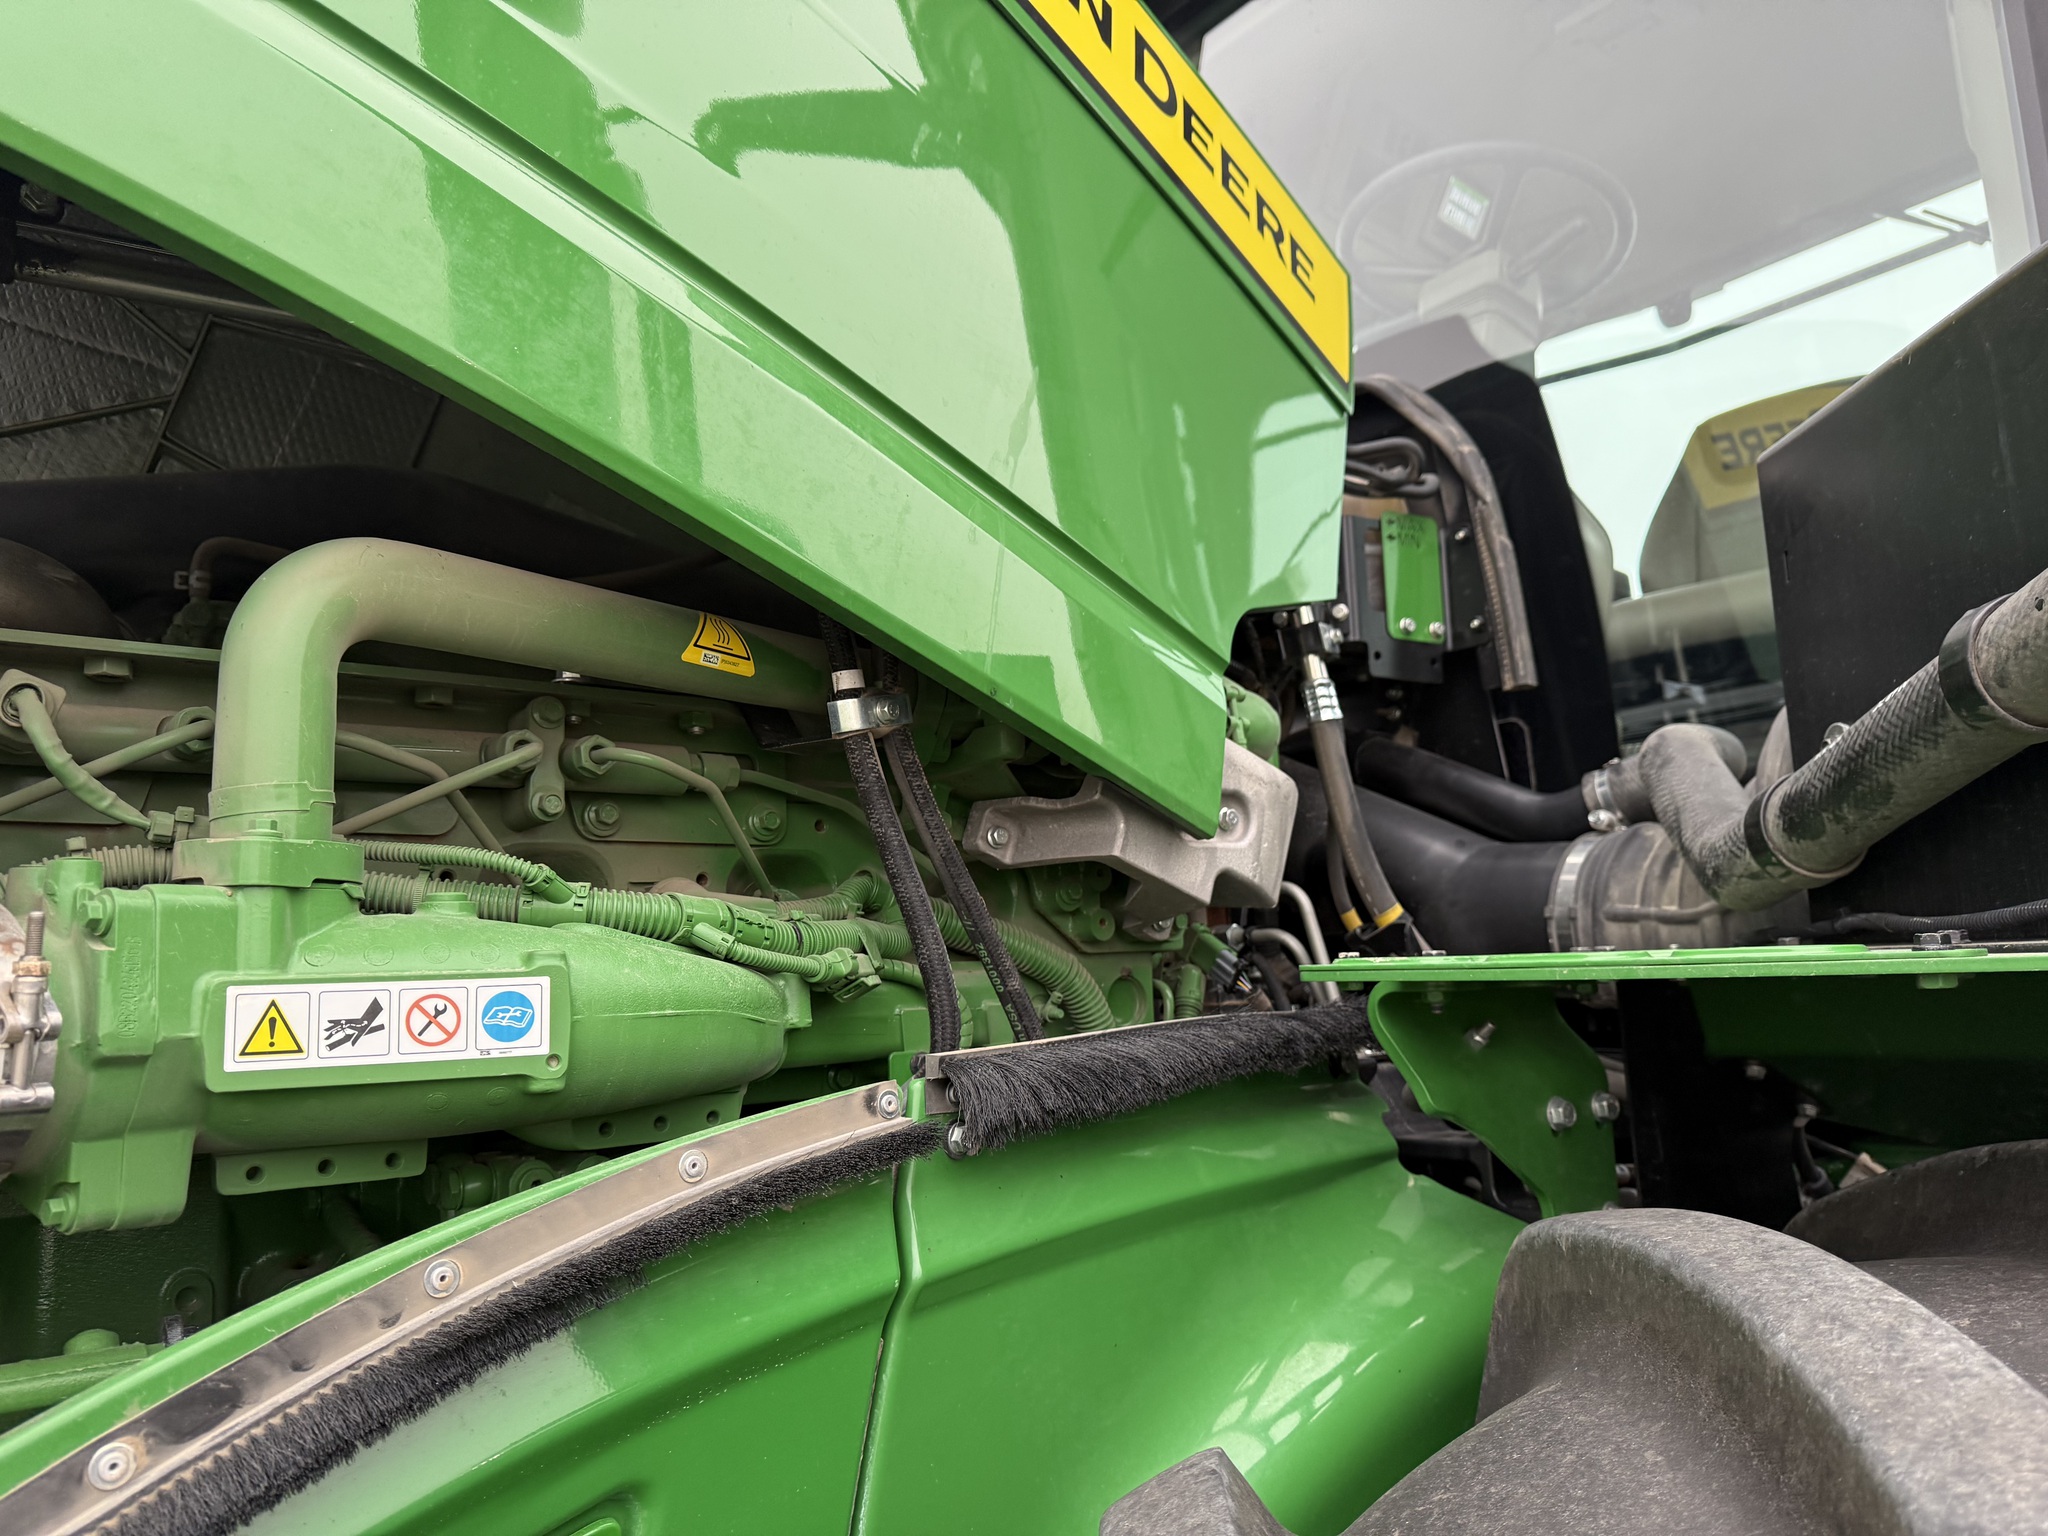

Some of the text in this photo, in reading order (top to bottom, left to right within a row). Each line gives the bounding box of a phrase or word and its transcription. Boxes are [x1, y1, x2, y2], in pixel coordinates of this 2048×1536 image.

[1135, 26, 1316, 305] DEERE
[975, 942, 1004, 993] 0001392
[1005, 1003, 1022, 1031] USA
